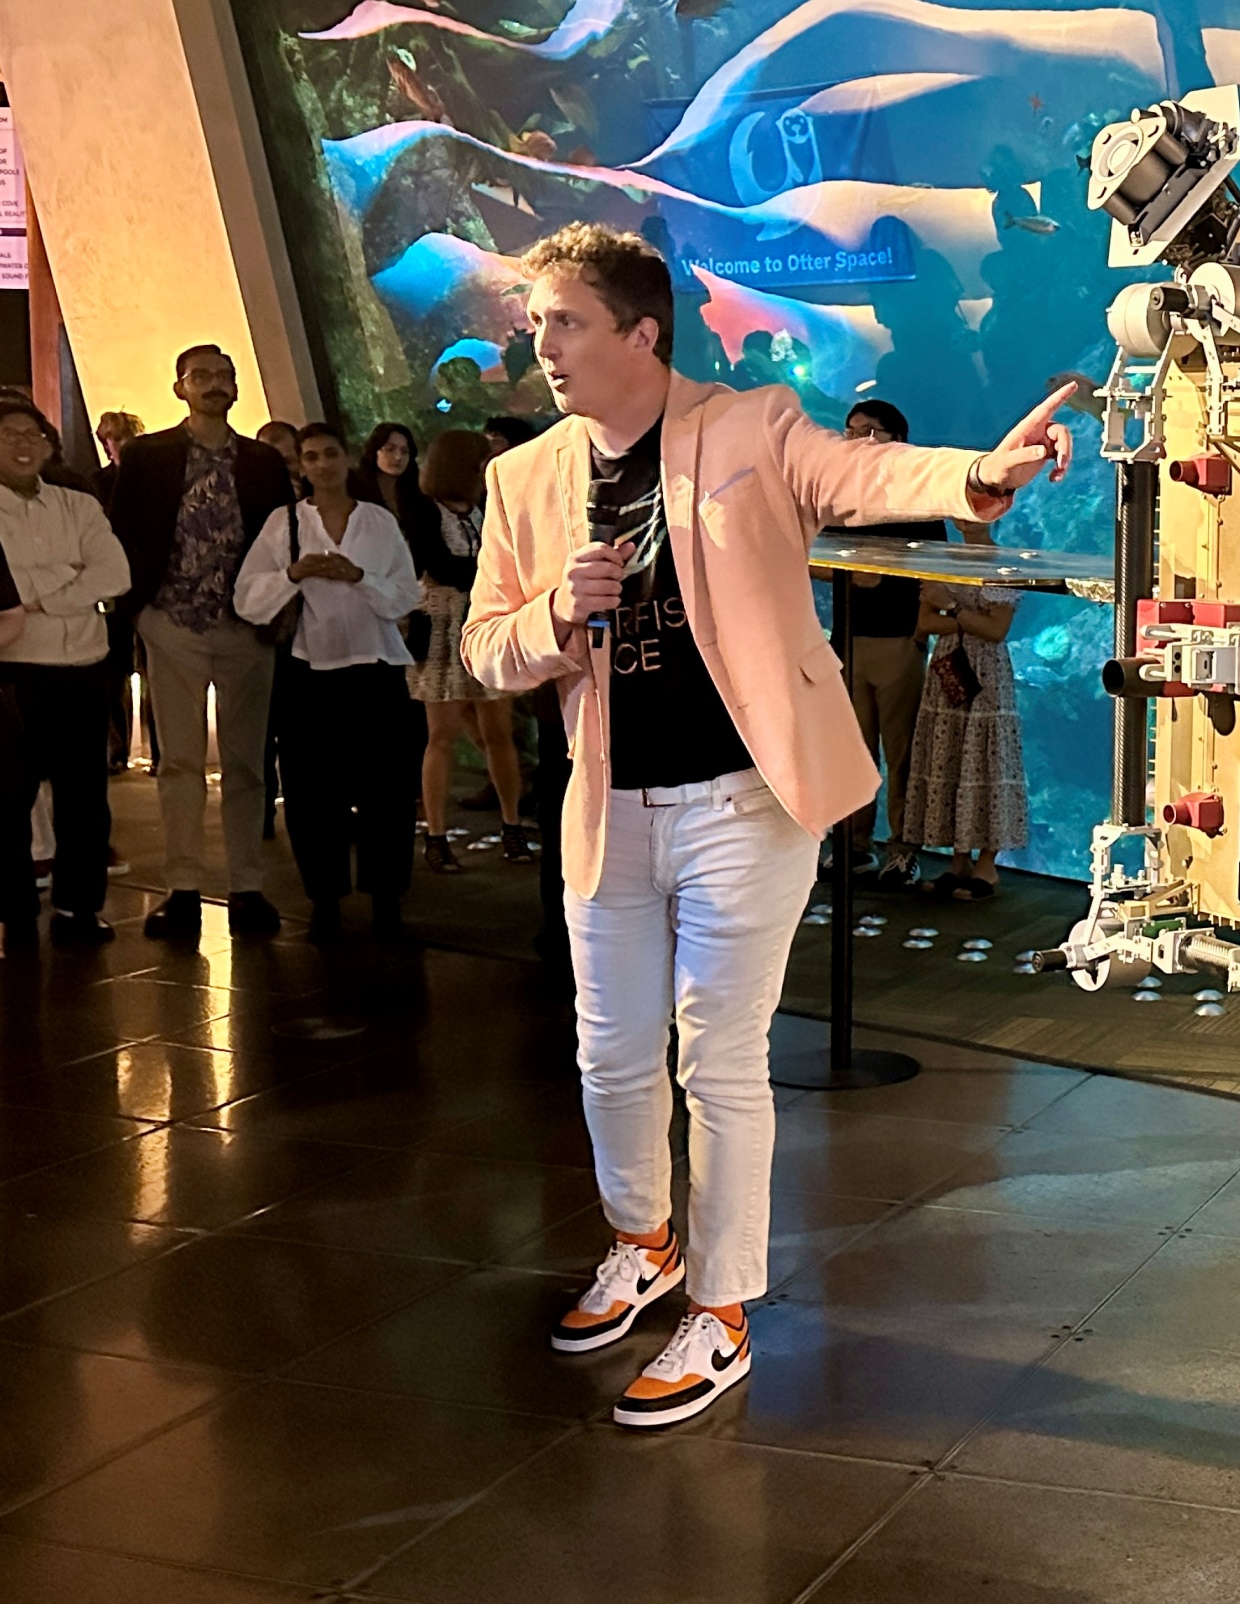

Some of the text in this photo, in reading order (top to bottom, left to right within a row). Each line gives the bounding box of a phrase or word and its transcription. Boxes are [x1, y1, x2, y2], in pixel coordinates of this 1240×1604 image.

[681, 247, 893, 276] Welcome to Otter Space!
[614, 597, 687, 638] RFIS
[613, 638, 662, 675] CE
